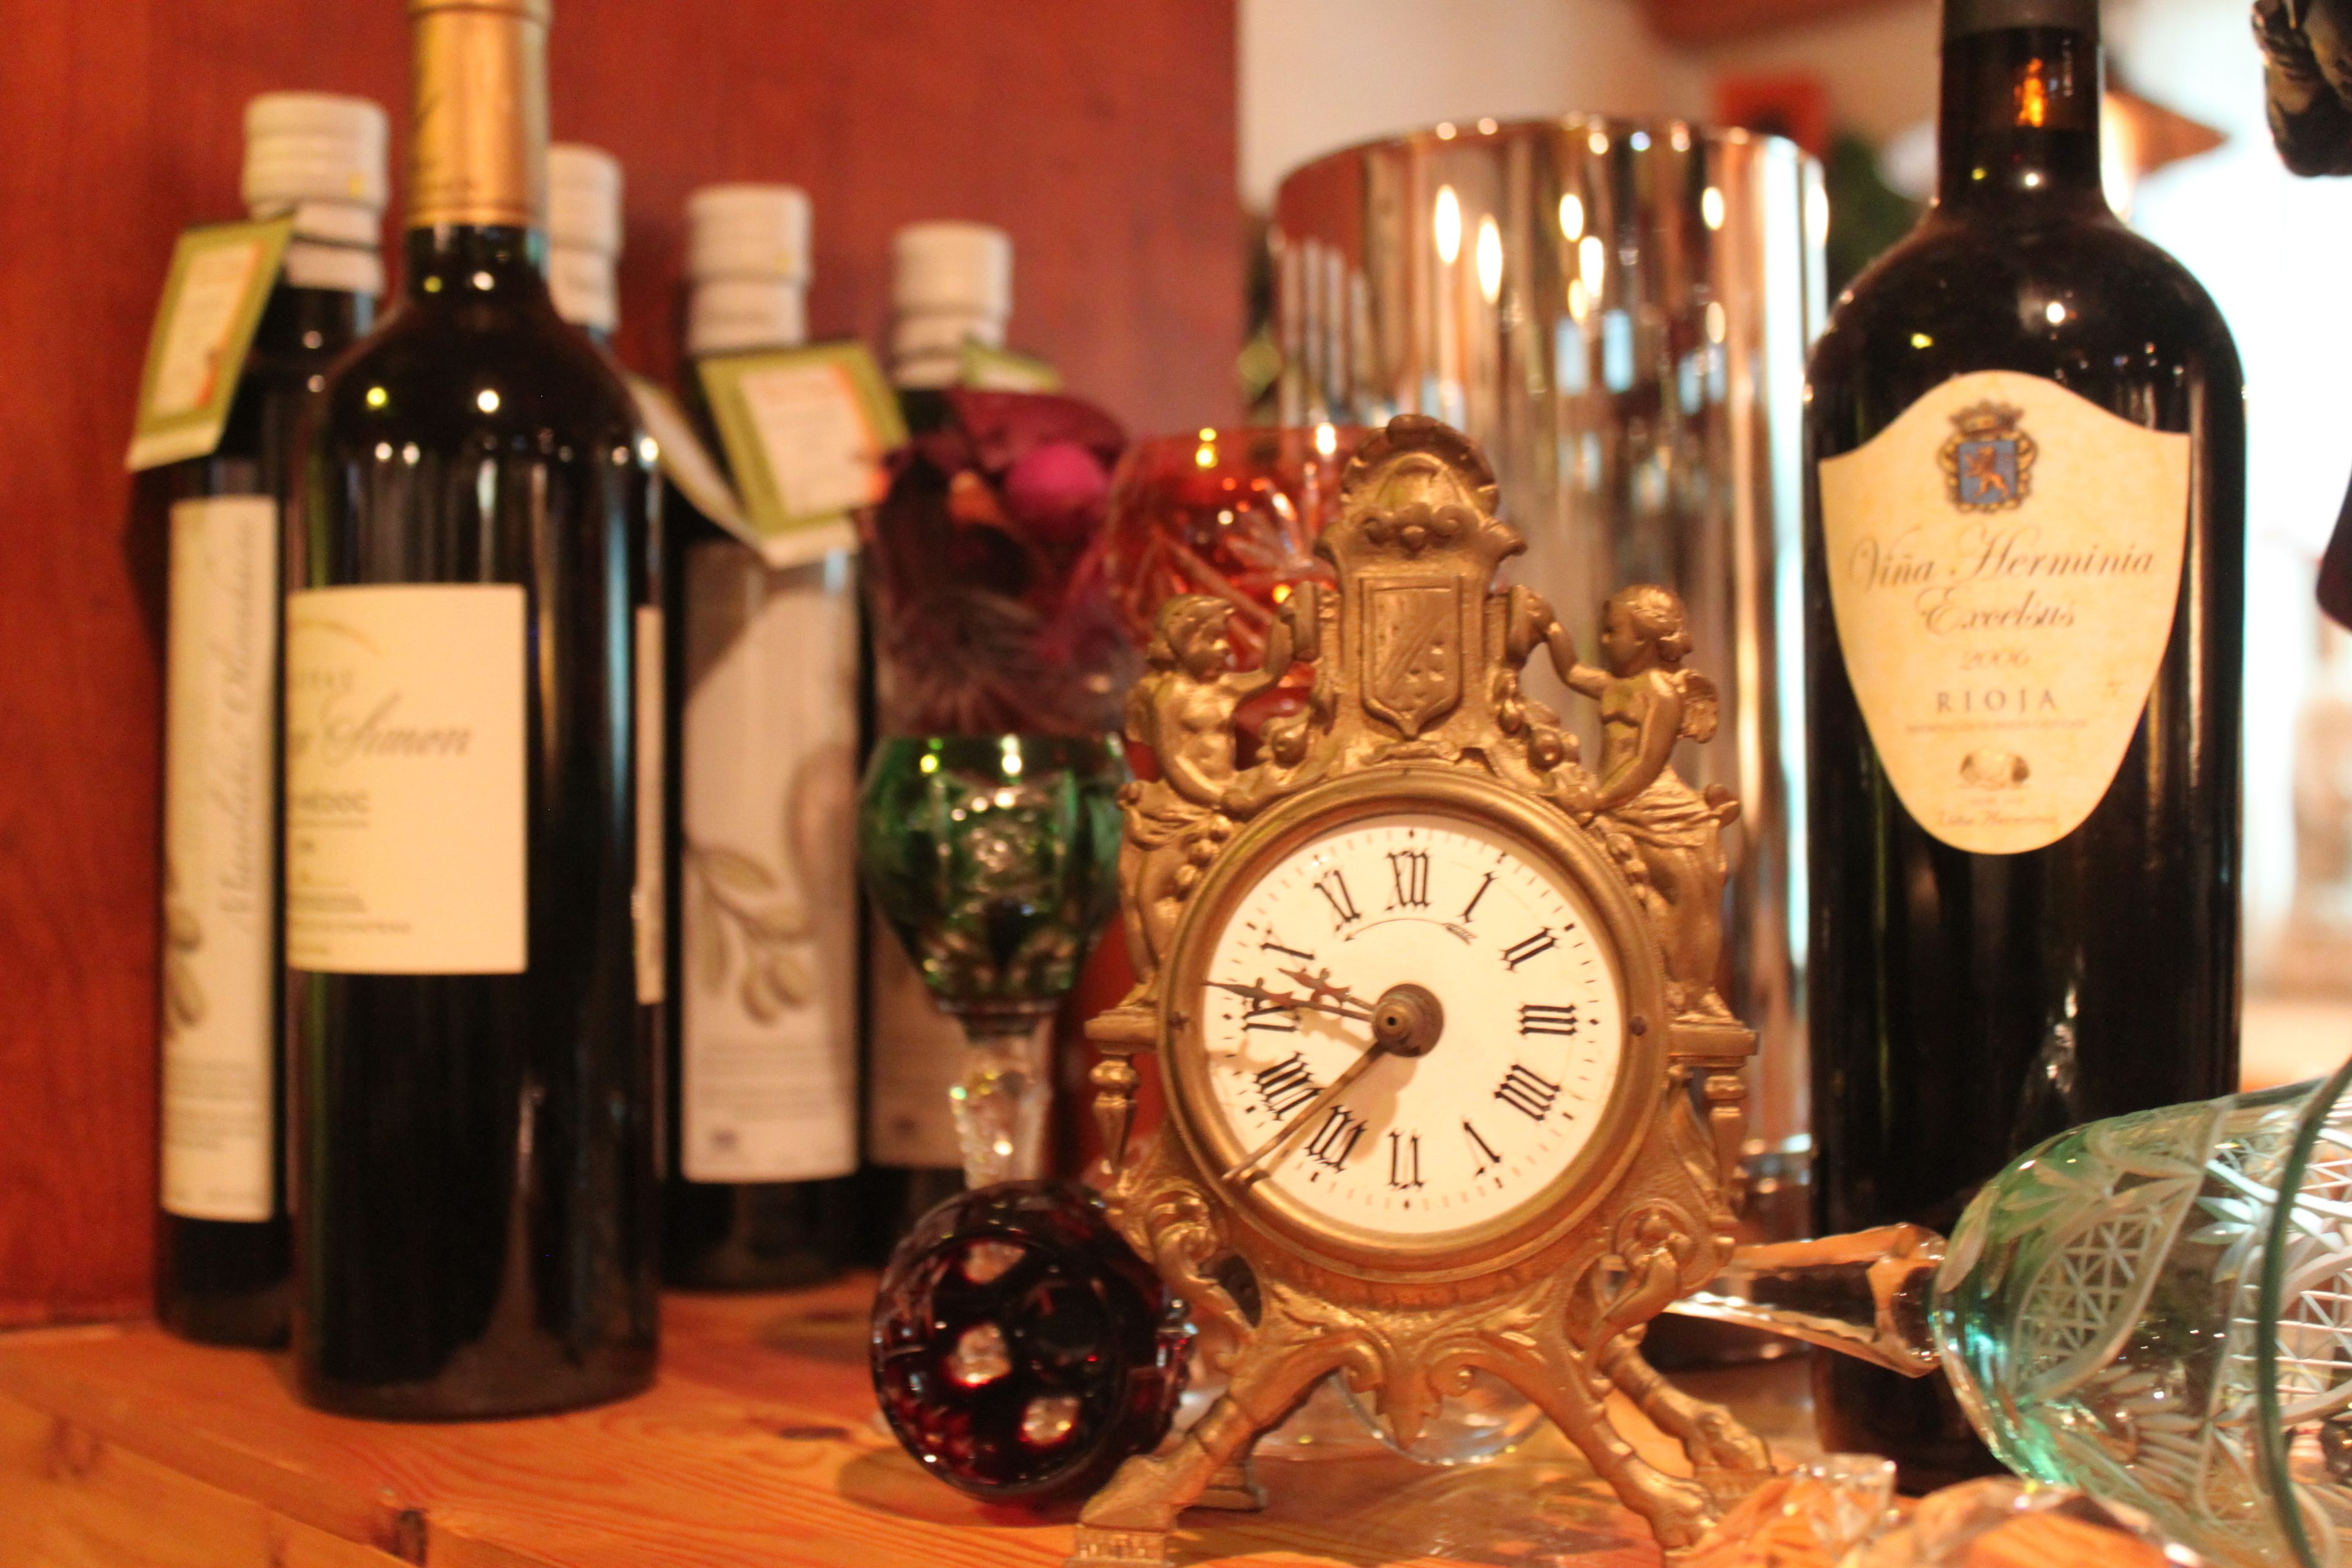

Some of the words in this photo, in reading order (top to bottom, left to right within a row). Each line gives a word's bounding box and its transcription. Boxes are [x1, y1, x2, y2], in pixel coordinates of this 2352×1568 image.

[1848, 524, 1935, 593] Viña
[1950, 524, 2155, 584] Herminia
[1937, 688, 2058, 715] RIOJA
[1312, 867, 1362, 932] XI
[1385, 849, 1432, 913] XII
[1458, 870, 1499, 924] I
[1498, 925, 1558, 972] II
[1518, 1003, 1578, 1036] III
[1493, 1063, 1561, 1122] IIII
[1304, 1105, 1368, 1174] VII
[1387, 1129, 1427, 1191] VI
[1461, 1120, 1502, 1179] V
